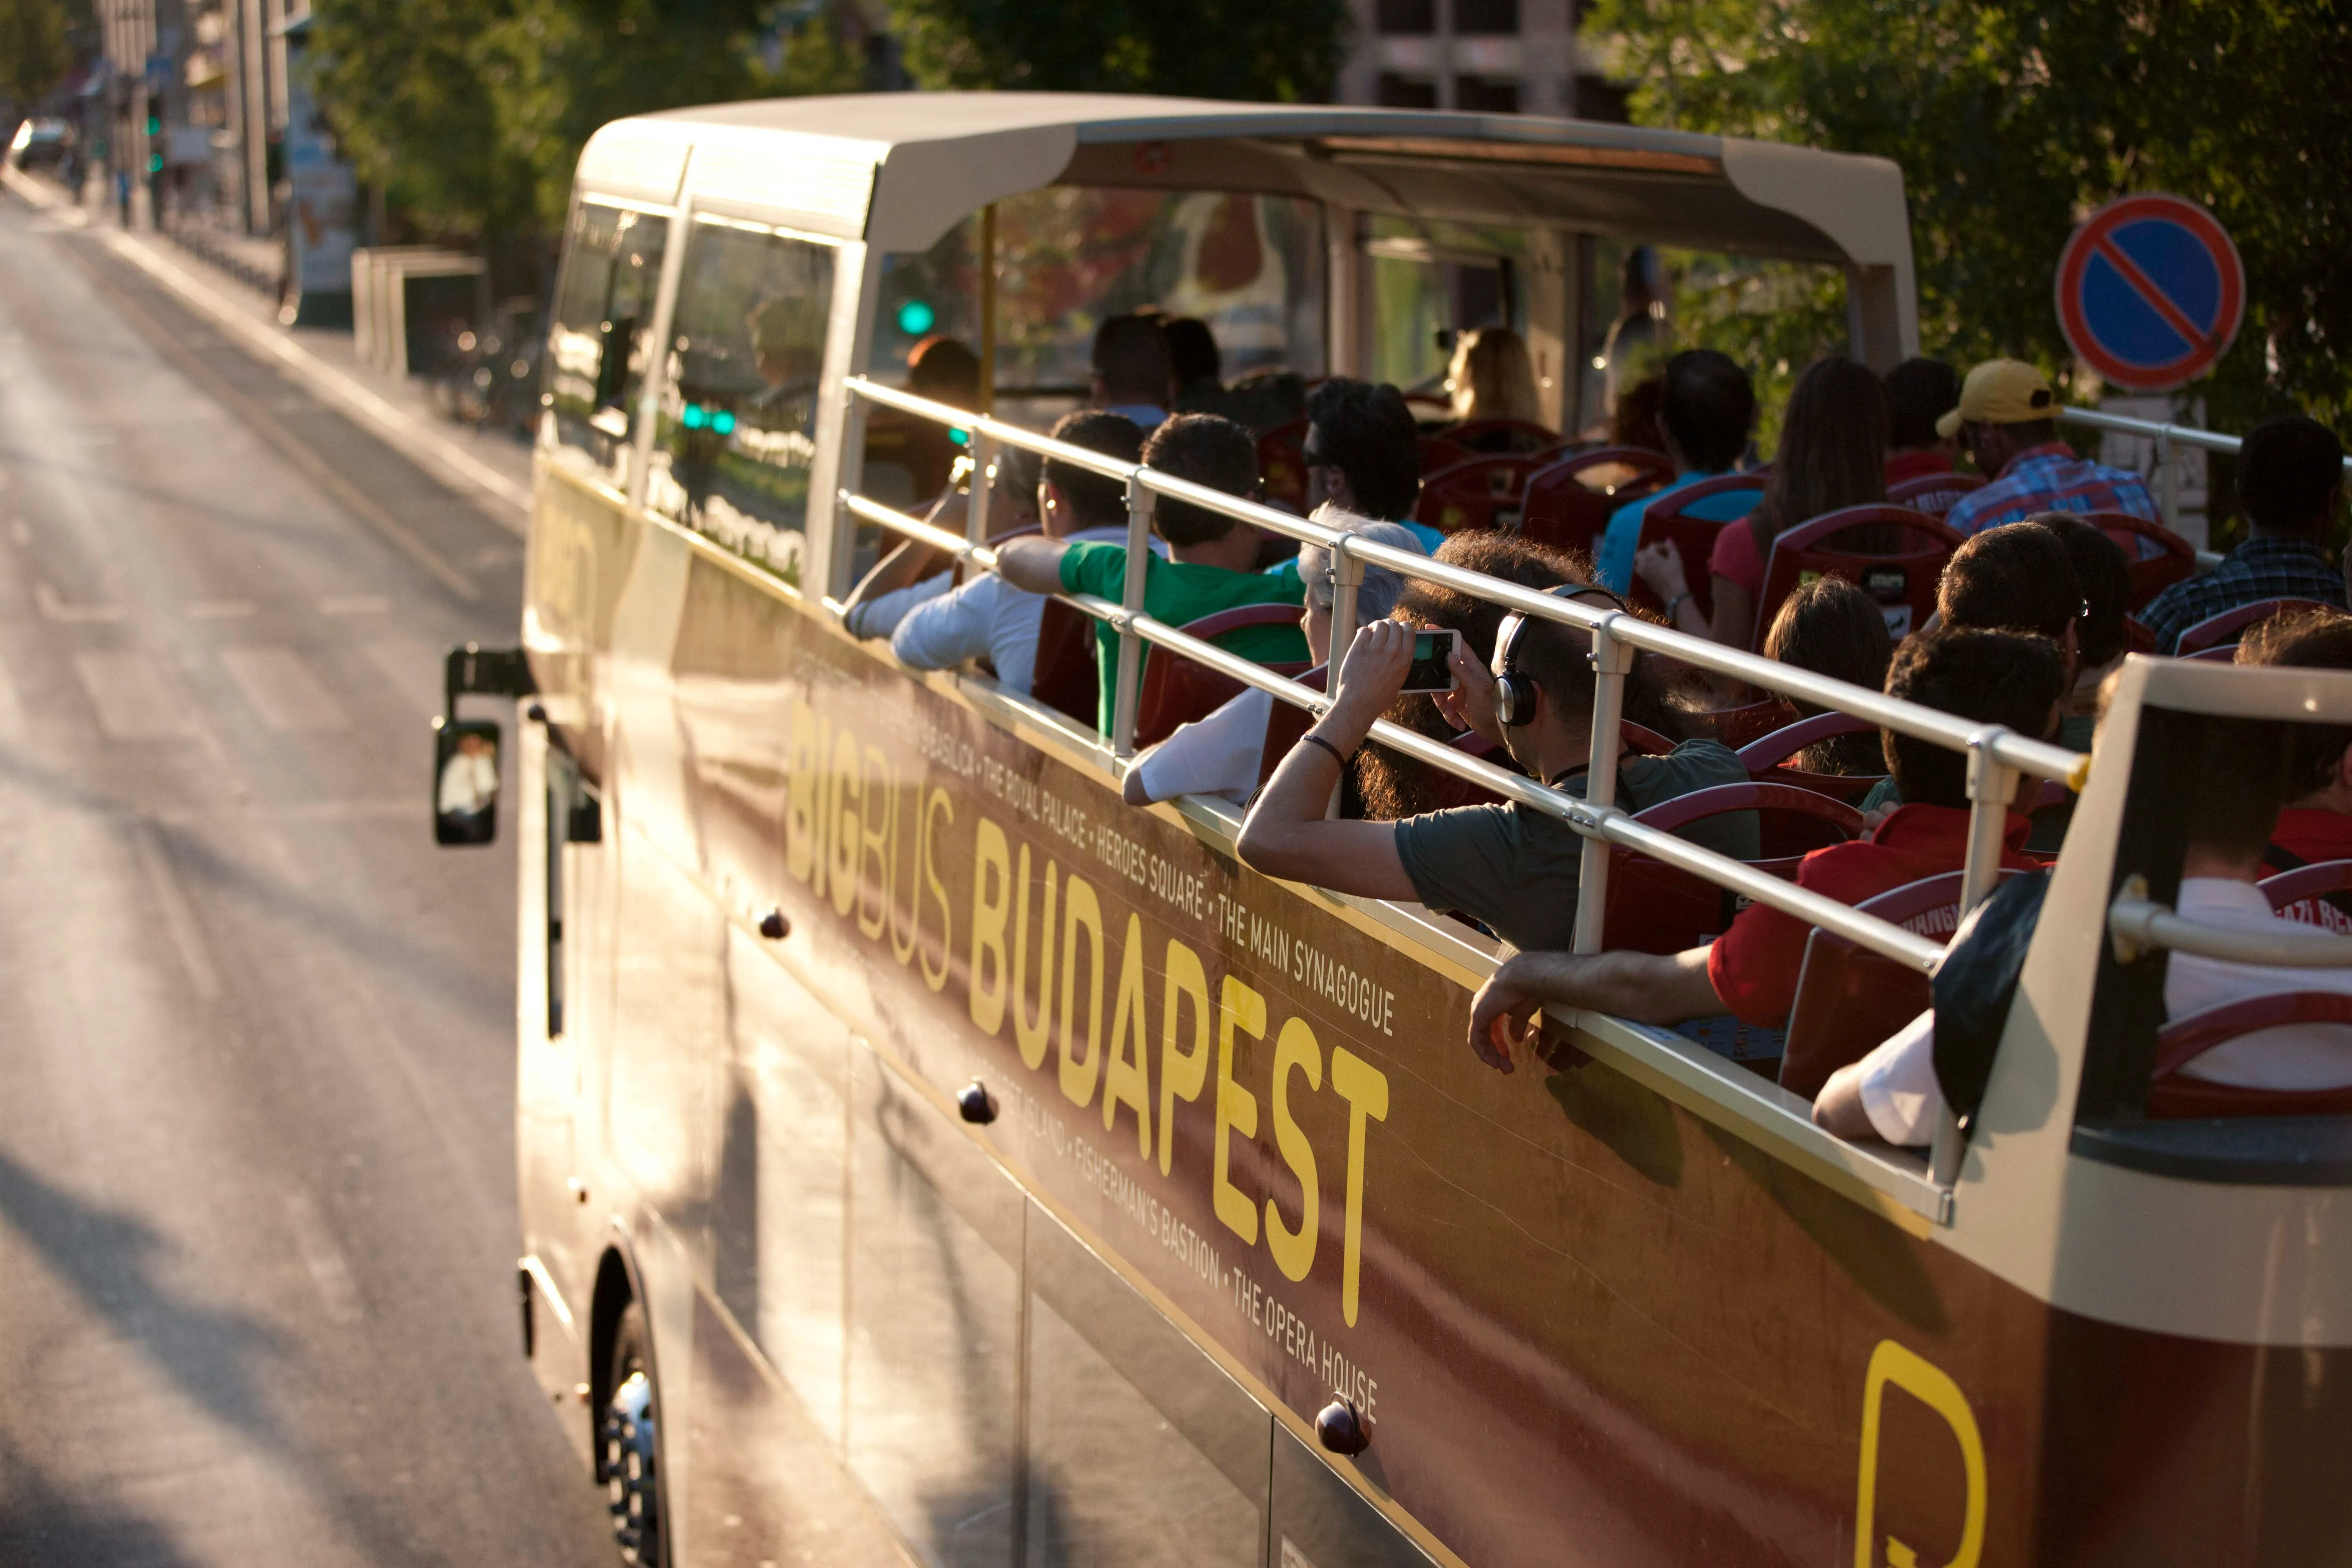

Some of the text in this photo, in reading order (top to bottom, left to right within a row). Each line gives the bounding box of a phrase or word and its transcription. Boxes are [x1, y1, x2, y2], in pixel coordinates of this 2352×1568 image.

[983, 755, 1003, 799] THE
[1006, 769, 1039, 821] ROYAL
[1043, 791, 1087, 849] PALACE
[1097, 823, 1146, 886] HEROES
[1149, 855, 1204, 921] SQUARE
[1218, 892, 1246, 947] THE
[1251, 913, 1289, 974] MAIN
[1294, 940, 1394, 1037] SYNAGOGUE
[970, 817, 1389, 1328] BUDAPEST
[1075, 1136, 1158, 1236] FISHERMAN'S
[1161, 1207, 1219, 1289] BASTION
[1233, 1266, 1261, 1327] THE
[1266, 1296, 1316, 1374] OPERA
[1322, 1341, 1377, 1424] HOUSE
